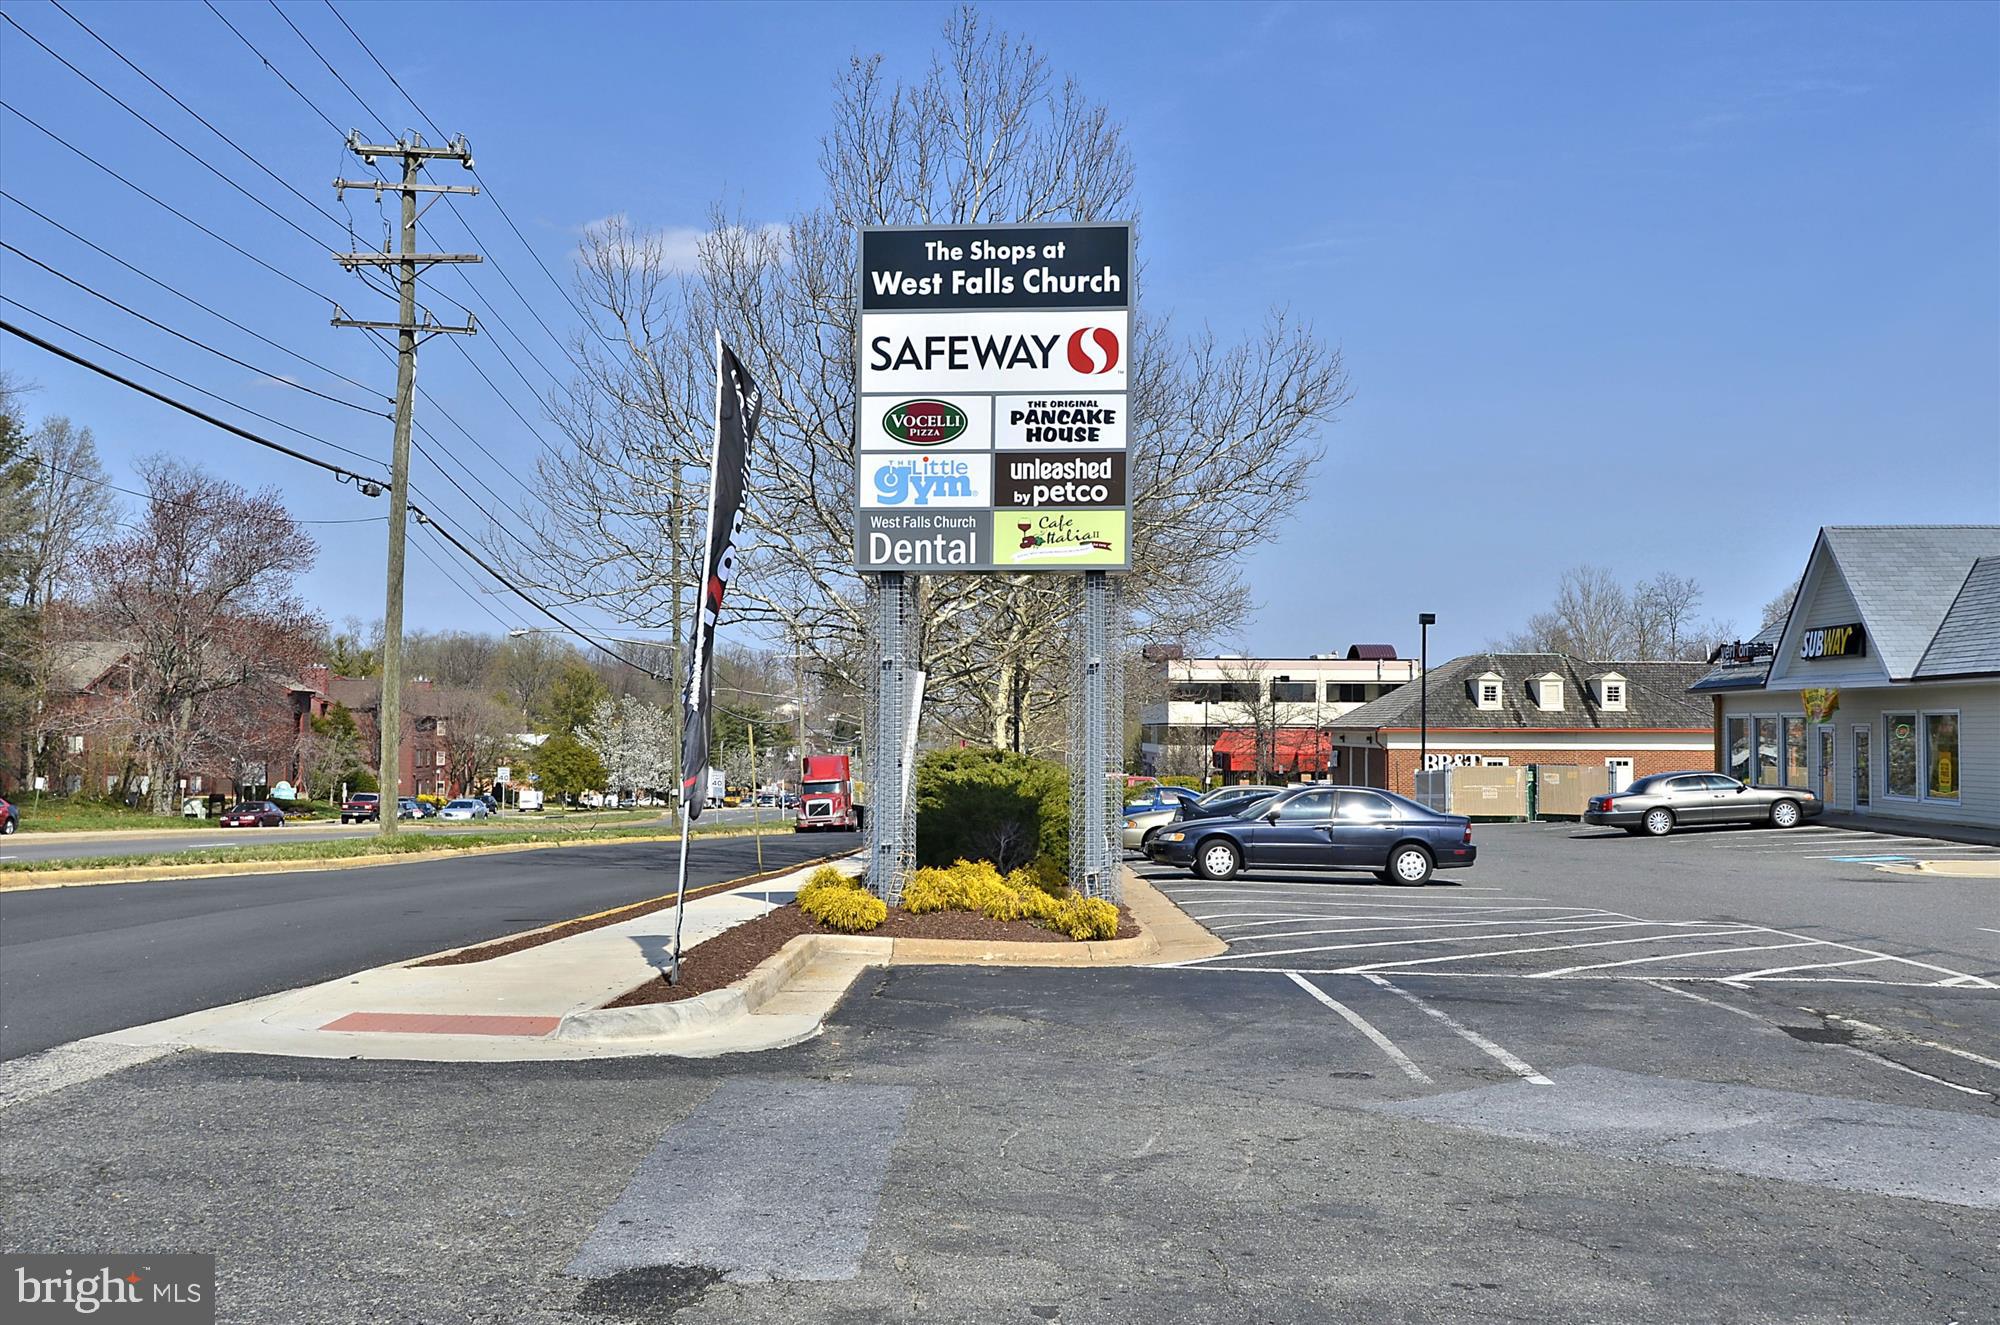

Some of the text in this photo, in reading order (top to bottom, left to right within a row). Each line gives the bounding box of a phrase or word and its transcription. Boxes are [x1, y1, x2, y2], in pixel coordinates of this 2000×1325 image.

[924, 239, 1066, 264] The Shops at
[871, 265, 1121, 296] West Falls Church
[870, 334, 1061, 371] SAFEWAY
[1050, 400, 1099, 408] ORIGINAL
[890, 413, 961, 428] VOCELLI
[1010, 409, 1116, 425] PANCAKE
[909, 428, 940, 437] PIZZA
[1026, 426, 1101, 443] HOUSE
[913, 456, 968, 475] Little
[1010, 456, 1111, 480] unleashed
[874, 465, 972, 505] gym
[1014, 481, 1108, 507] by petco
[870, 515, 976, 529] West Falls Church
[1039, 514, 1073, 531] Cafe
[1046, 529, 1092, 544] Italia
[869, 531, 976, 565] Dental
[1800, 626, 1852, 658] SUBWAY
